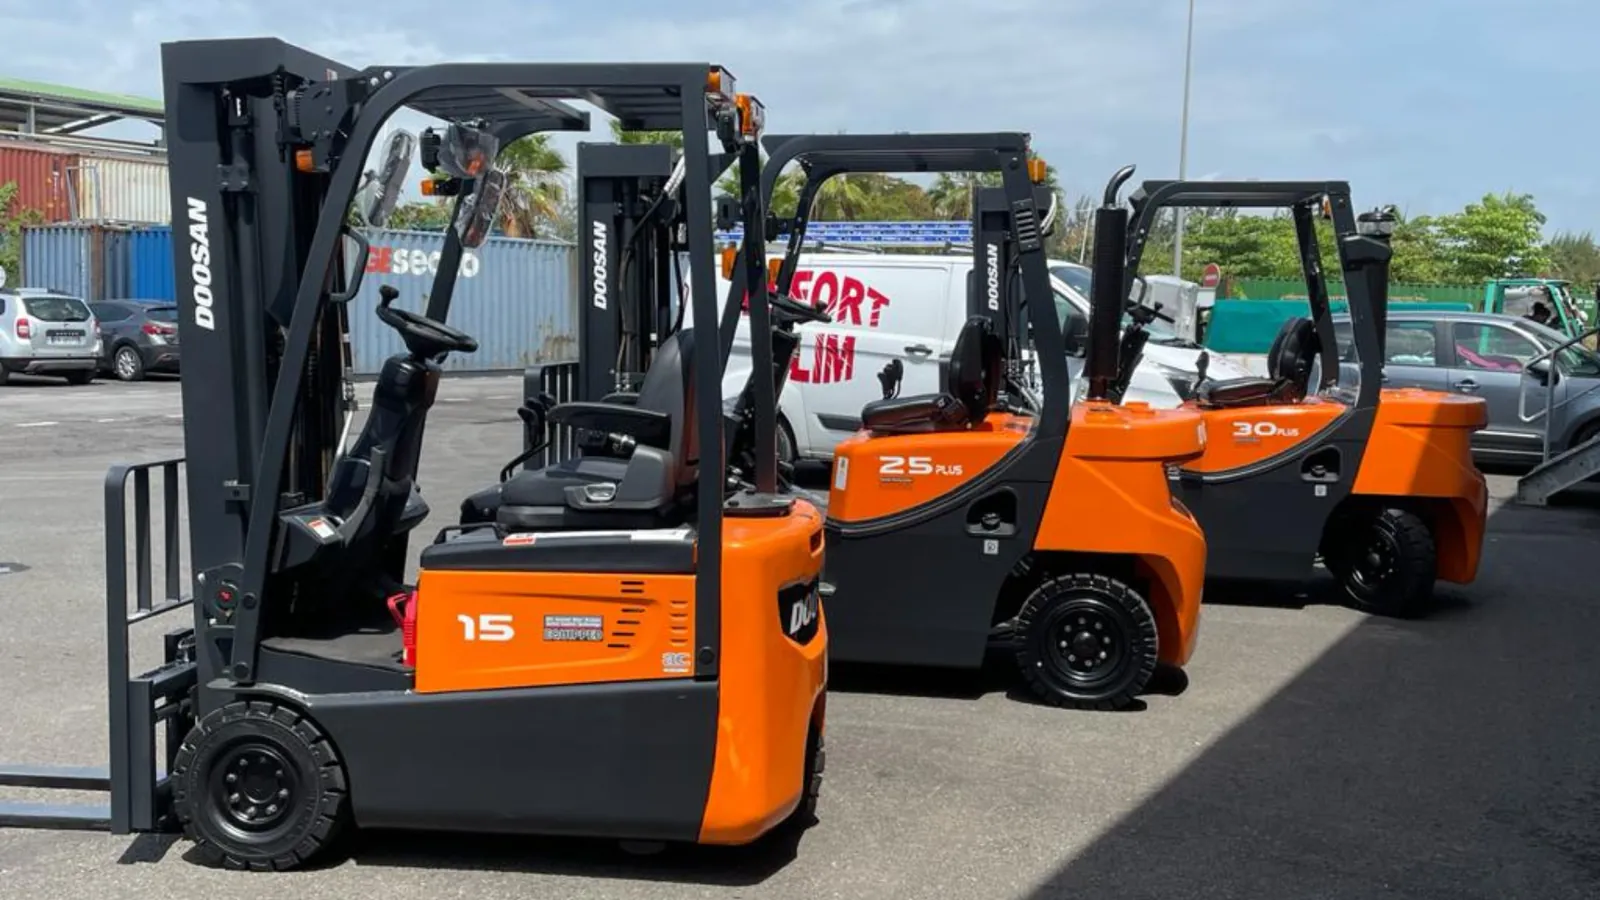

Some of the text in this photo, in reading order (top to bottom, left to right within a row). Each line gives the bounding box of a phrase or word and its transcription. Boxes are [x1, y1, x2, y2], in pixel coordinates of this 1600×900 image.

[187, 197, 215, 330] DOOSAN
[593, 220, 607, 310] DOOSAN
[987, 243, 999, 310] DOOSAN
[1232, 421, 1299, 437] 30 PLUS
[879, 456, 963, 476] 25 PLUS
[457, 614, 515, 641] 15
